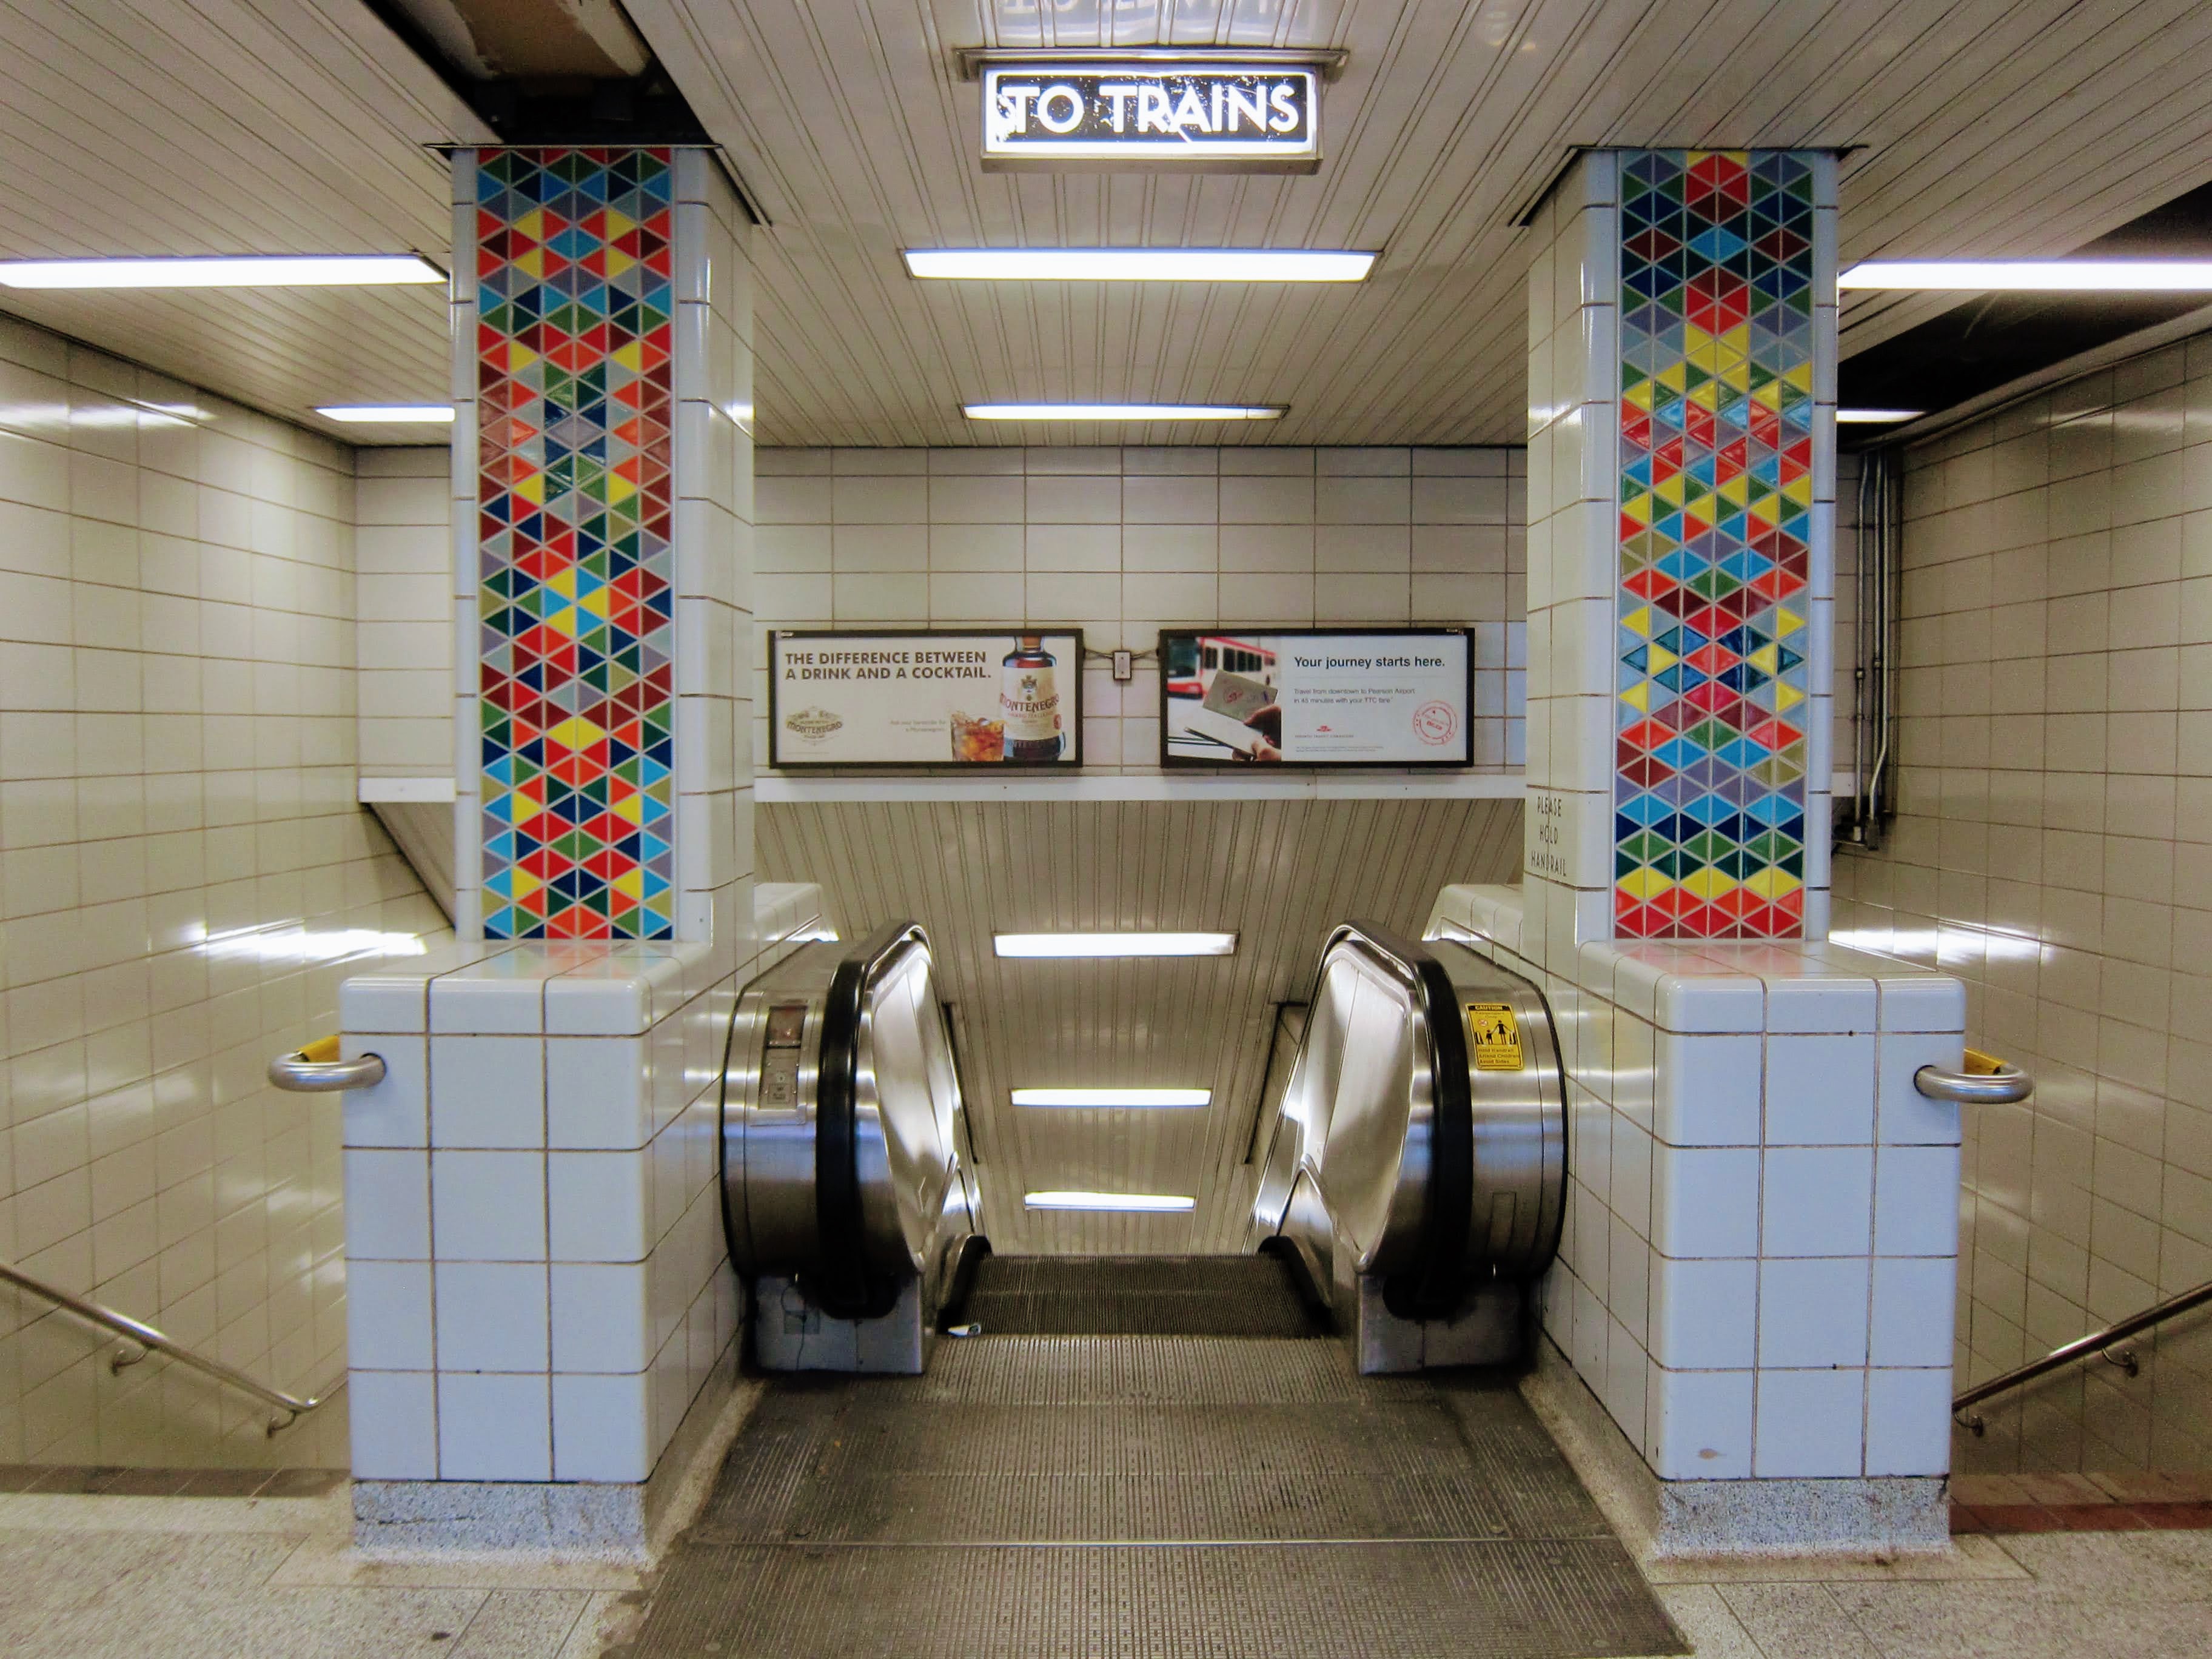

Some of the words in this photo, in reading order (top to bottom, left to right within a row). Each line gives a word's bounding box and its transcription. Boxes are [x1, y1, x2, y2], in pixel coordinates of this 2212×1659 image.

[1002, 84, 1085, 133] TO
[1099, 84, 1299, 133] TRAINS
[786, 652, 813, 665] THE
[819, 652, 910, 664] DIFFERENCE
[915, 651, 987, 663] BETWEEN
[1294, 657, 1322, 667] Your
[1326, 657, 1372, 669] journey
[1376, 657, 1410, 667] starts
[1415, 657, 1445, 667] here.
[785, 668, 796, 680] A
[802, 668, 851, 680] DRINK
[856, 668, 890, 679] AND
[896, 667, 907, 679] A
[912, 666, 991, 679] COCKTAIL.
[1537, 796, 1562, 817] PLEASE
[1540, 824, 1558, 845] HOLD
[1530, 850, 1567, 877] HANDRAIL
